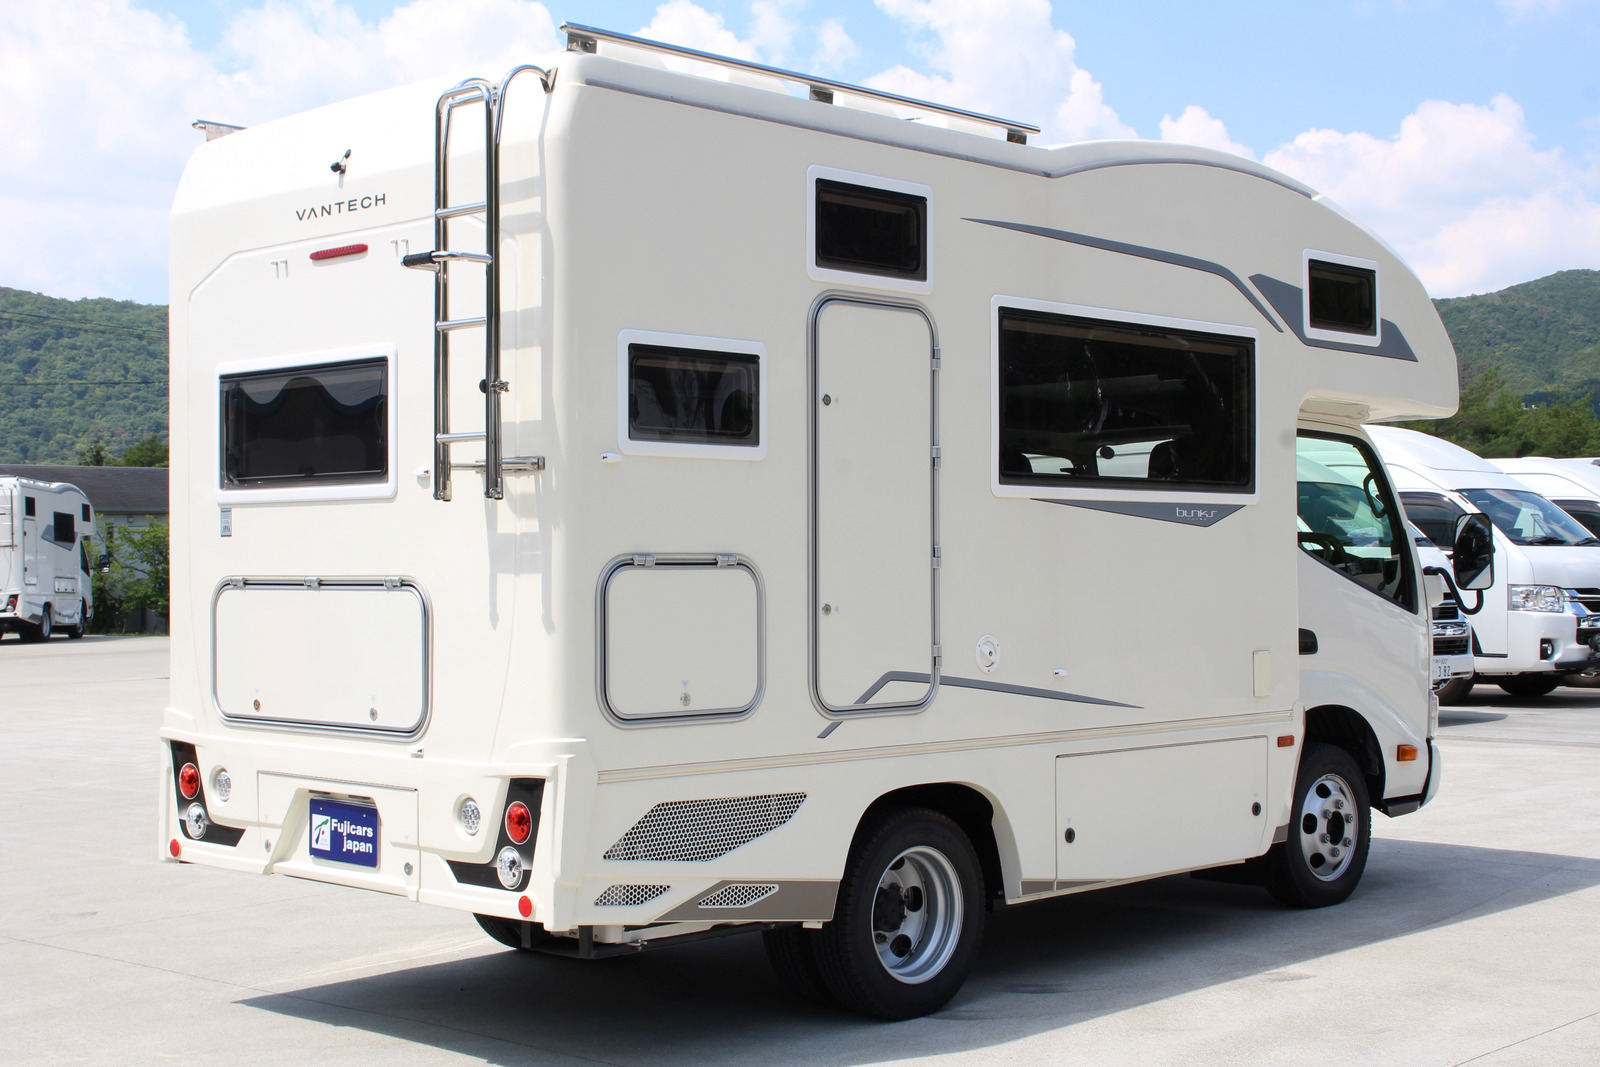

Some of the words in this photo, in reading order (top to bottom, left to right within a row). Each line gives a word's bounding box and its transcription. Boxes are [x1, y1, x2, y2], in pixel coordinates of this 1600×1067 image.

[296, 193, 386, 221] VANTECH
[331, 818, 374, 837] Fujicars
[342, 836, 373, 853] japan
